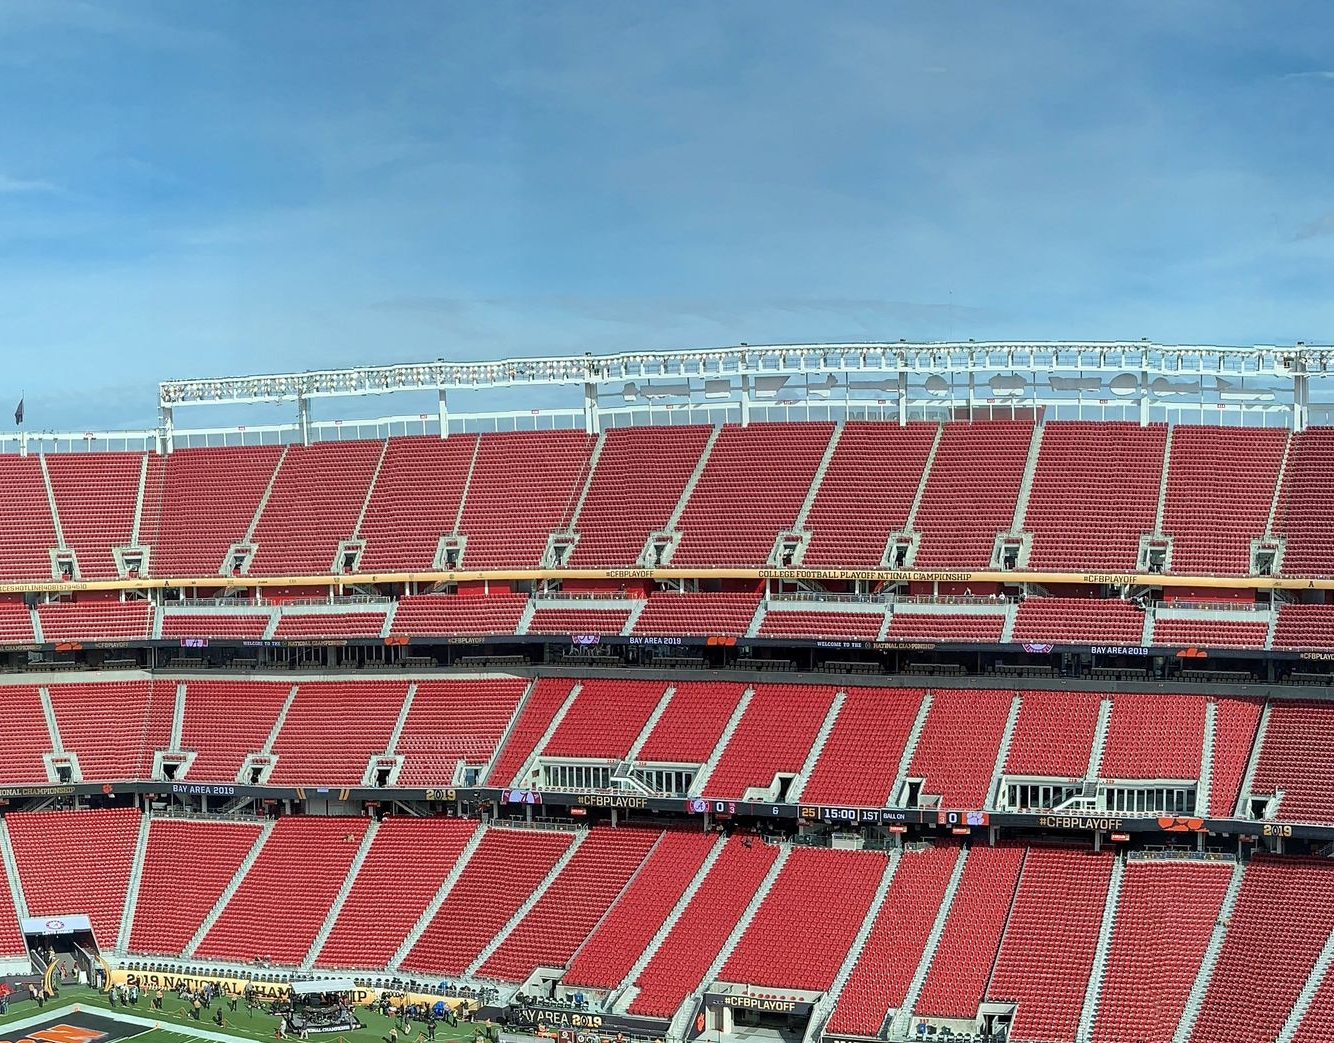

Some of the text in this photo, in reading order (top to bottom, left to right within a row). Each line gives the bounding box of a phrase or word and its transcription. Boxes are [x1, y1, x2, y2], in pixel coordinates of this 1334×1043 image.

[605, 570, 654, 578] #CFBPLAYOFF
[758, 570, 794, 578] COLLEGE
[795, 571, 839, 579] FOOTBALL
[840, 571, 876, 579] PLAYOFF
[1083, 575, 1137, 584] #CFBPLAYOFF
[663, 637, 682, 645] 2019
[1091, 646, 1148, 655] BAY AREA 2019
[22, 786, 76, 796] CHAMPIONSHIP
[172, 784, 235, 795] BAY AREA 2019
[577, 795, 647, 809] #CFBPLAYOFF
[801, 808, 816, 817] 25
[823, 808, 855, 819] 15:00
[862, 810, 879, 820] 1ST
[1039, 817, 1123, 830] #CFBPLAYOFF
[1263, 825, 1292, 837] 2019
[163, 975, 242, 995] NATIONAL
[725, 996, 796, 1012] #CFBPLAYOFF
[536, 1011, 569, 1026] AREA
[571, 1014, 603, 1029] 2019
